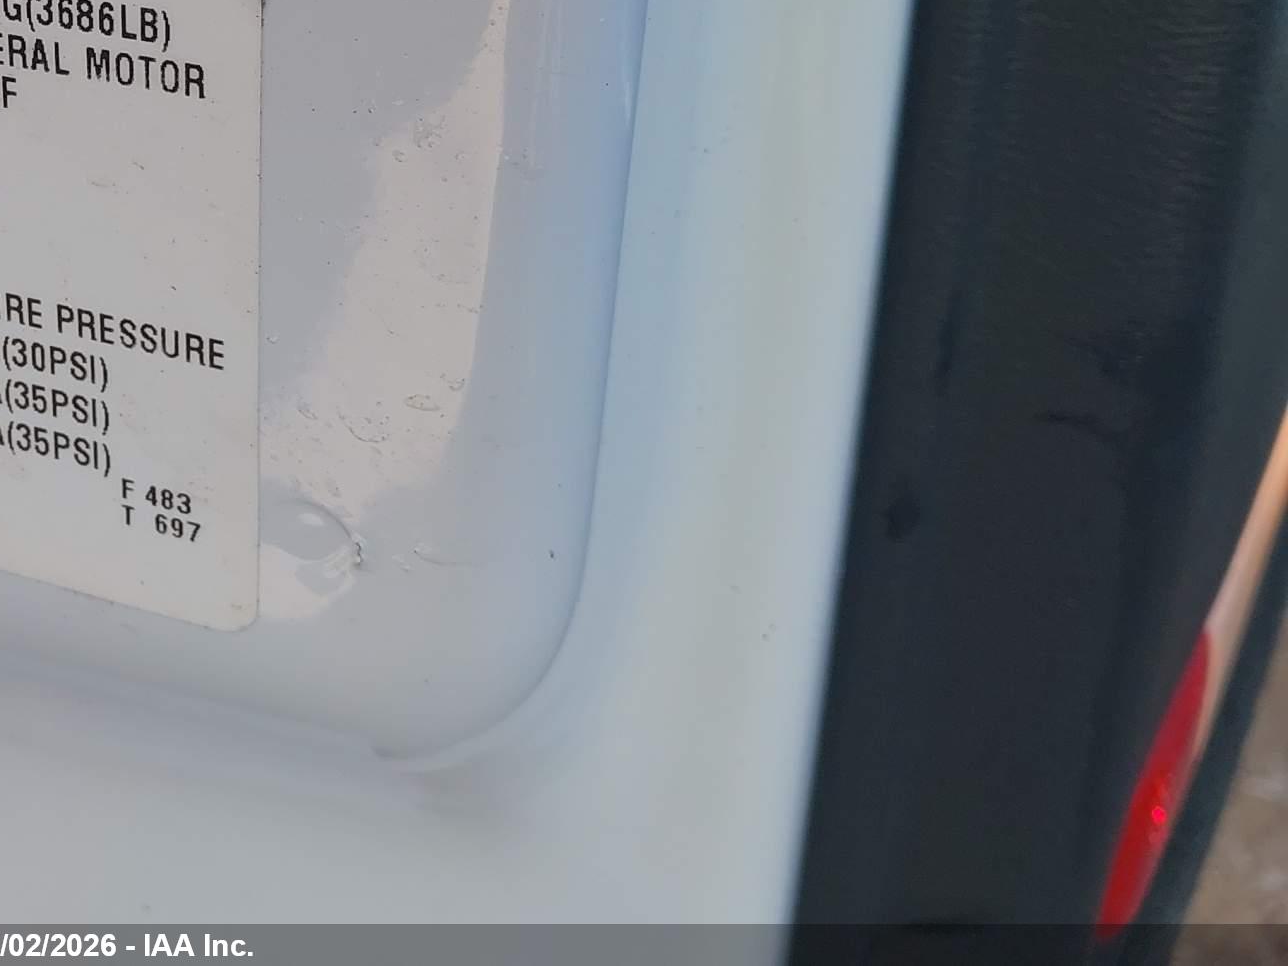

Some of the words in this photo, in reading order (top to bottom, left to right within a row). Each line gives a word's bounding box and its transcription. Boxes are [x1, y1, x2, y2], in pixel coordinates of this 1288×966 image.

[86, 47, 206, 99] MOTOR
[56, 304, 224, 370] PRESSURE
[121, 478, 134, 499] F
[145, 485, 191, 514] 483
[121, 504, 135, 526] T
[155, 514, 201, 542] 697
